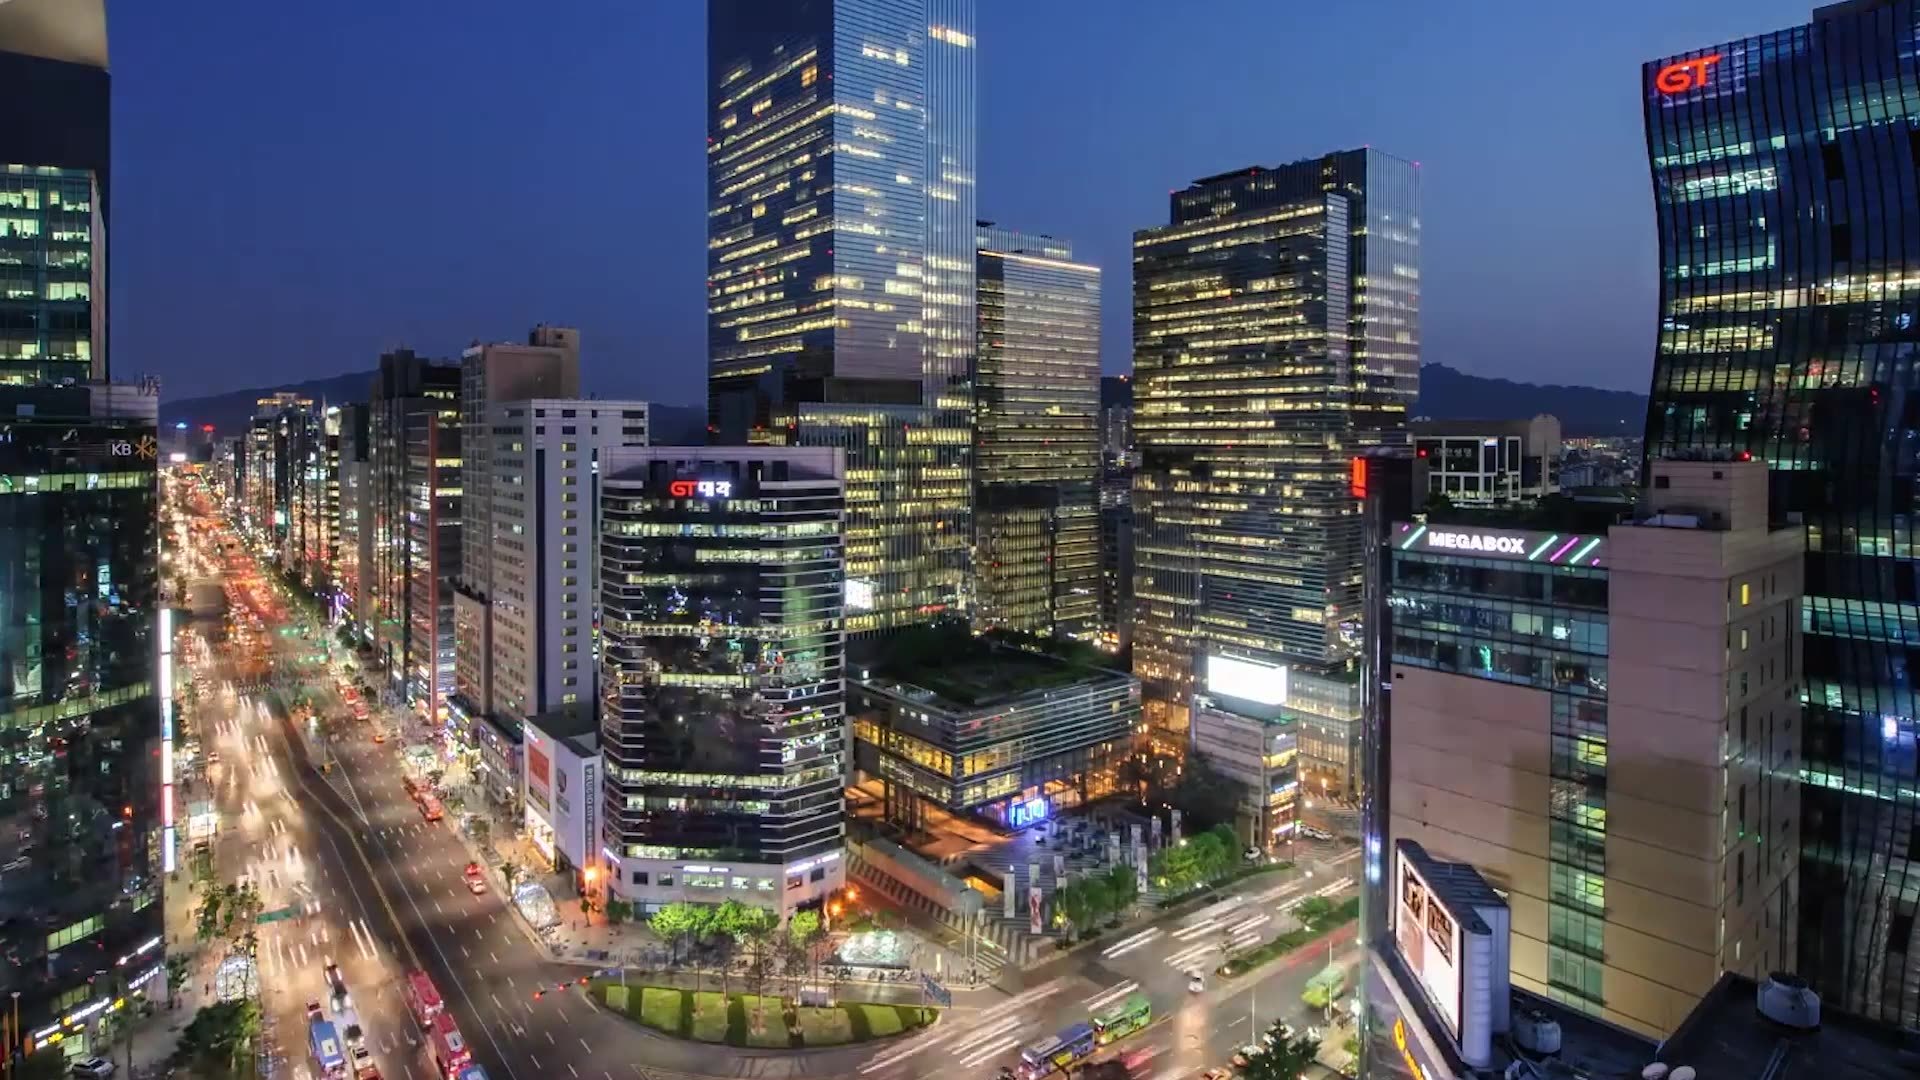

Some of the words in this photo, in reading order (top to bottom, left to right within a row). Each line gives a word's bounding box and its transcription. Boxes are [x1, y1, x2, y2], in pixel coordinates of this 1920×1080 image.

[1656, 54, 1723, 93] GT
[111, 443, 133, 457] KB
[1428, 531, 1526, 555] MEGABOX
